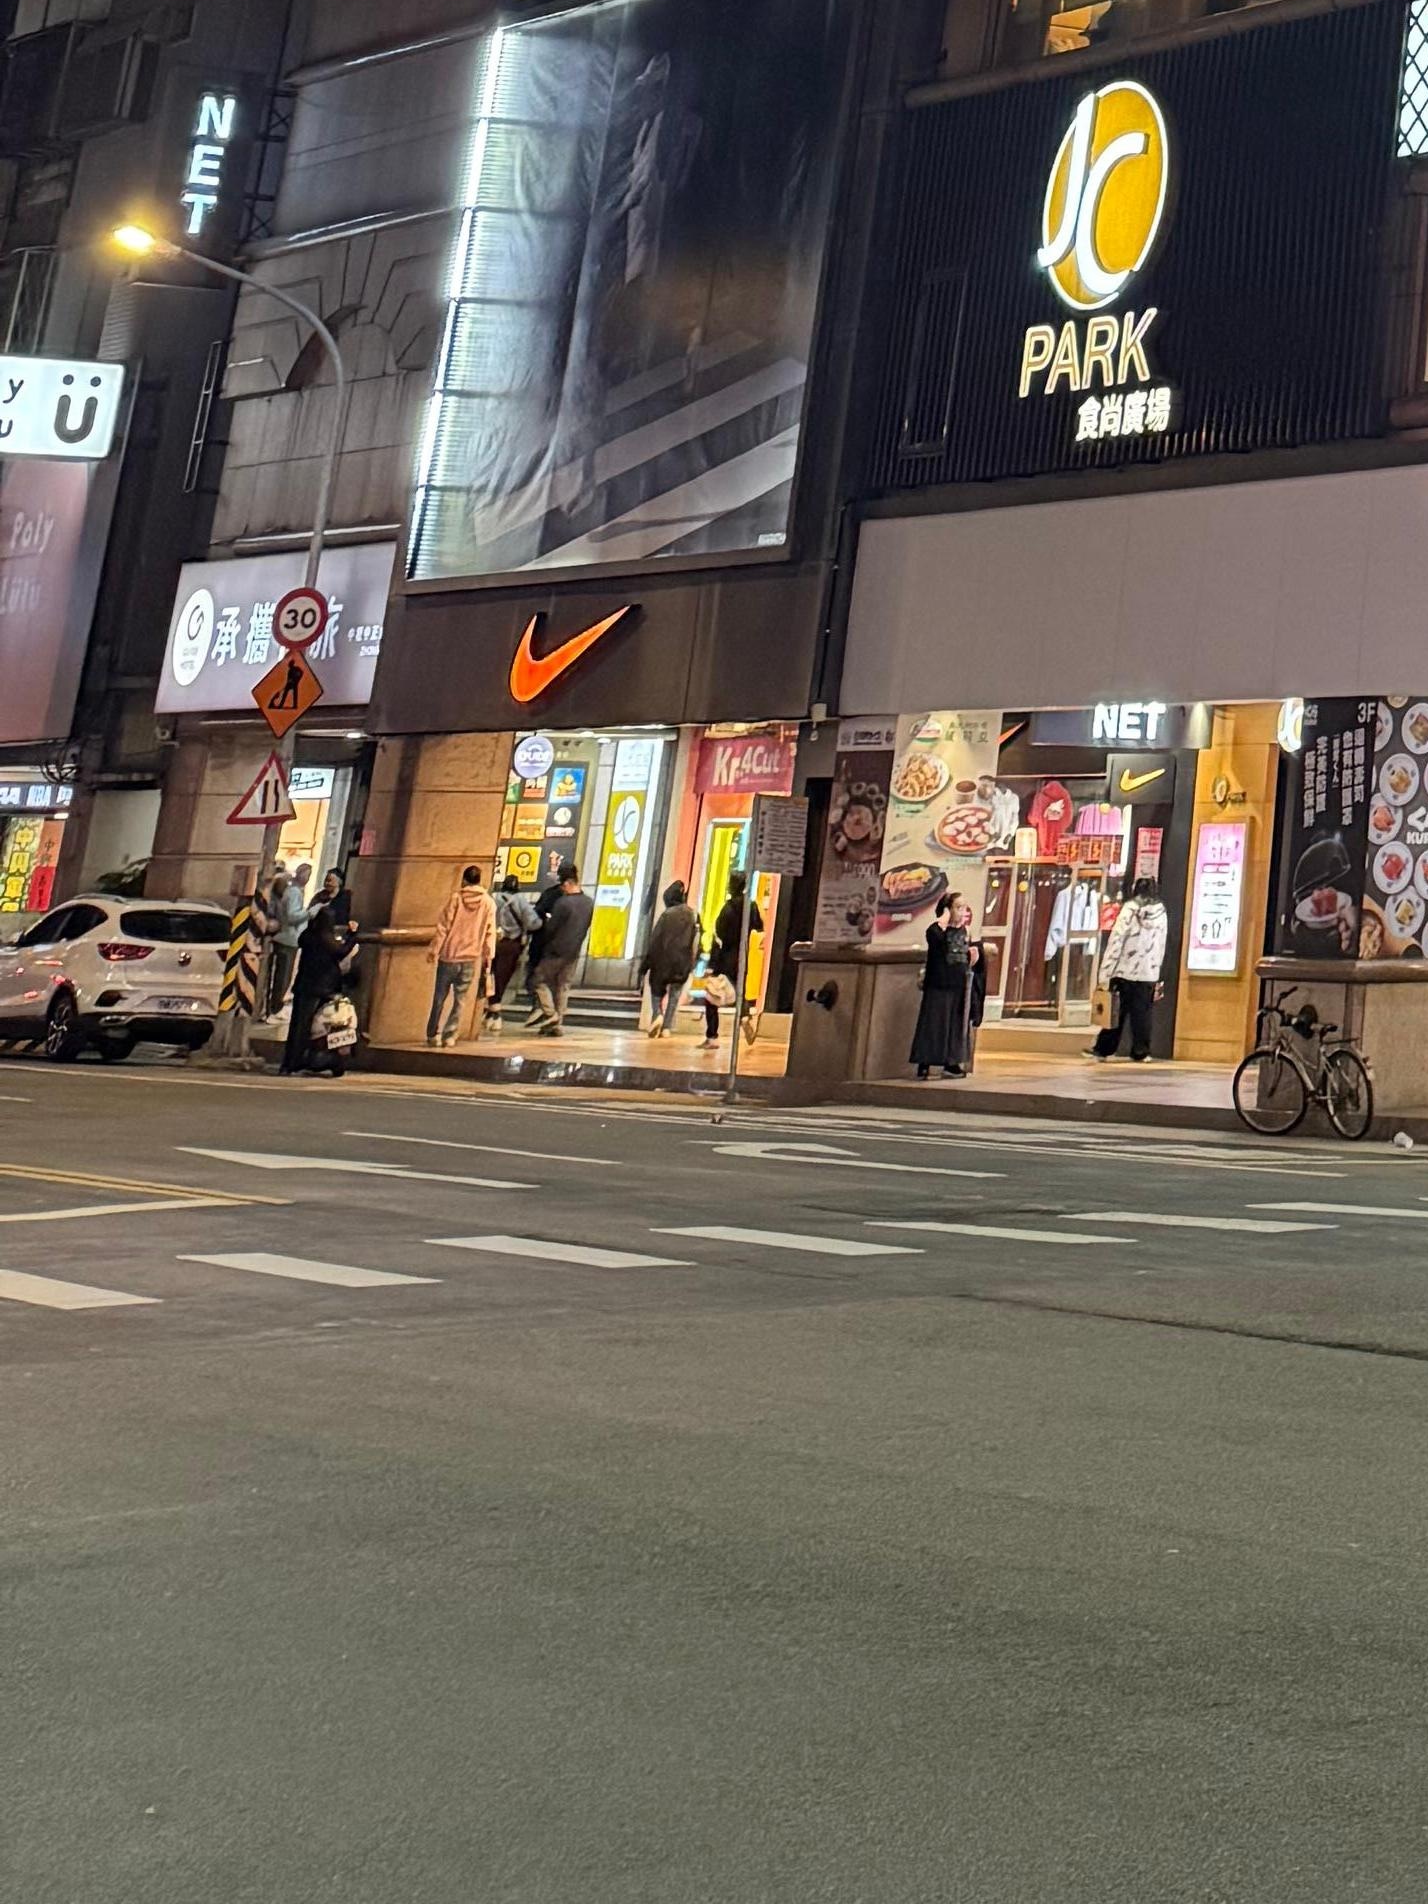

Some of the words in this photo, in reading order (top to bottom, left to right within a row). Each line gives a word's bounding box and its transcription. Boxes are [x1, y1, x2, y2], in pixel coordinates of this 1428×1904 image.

[180, 93, 237, 235] NET
[1018, 306, 1158, 399] PARK
[1074, 386, 1173, 443] 食尚廣場
[283, 607, 317, 630] 30
[1092, 700, 1167, 741] NET
[1357, 702, 1377, 724] 3F
